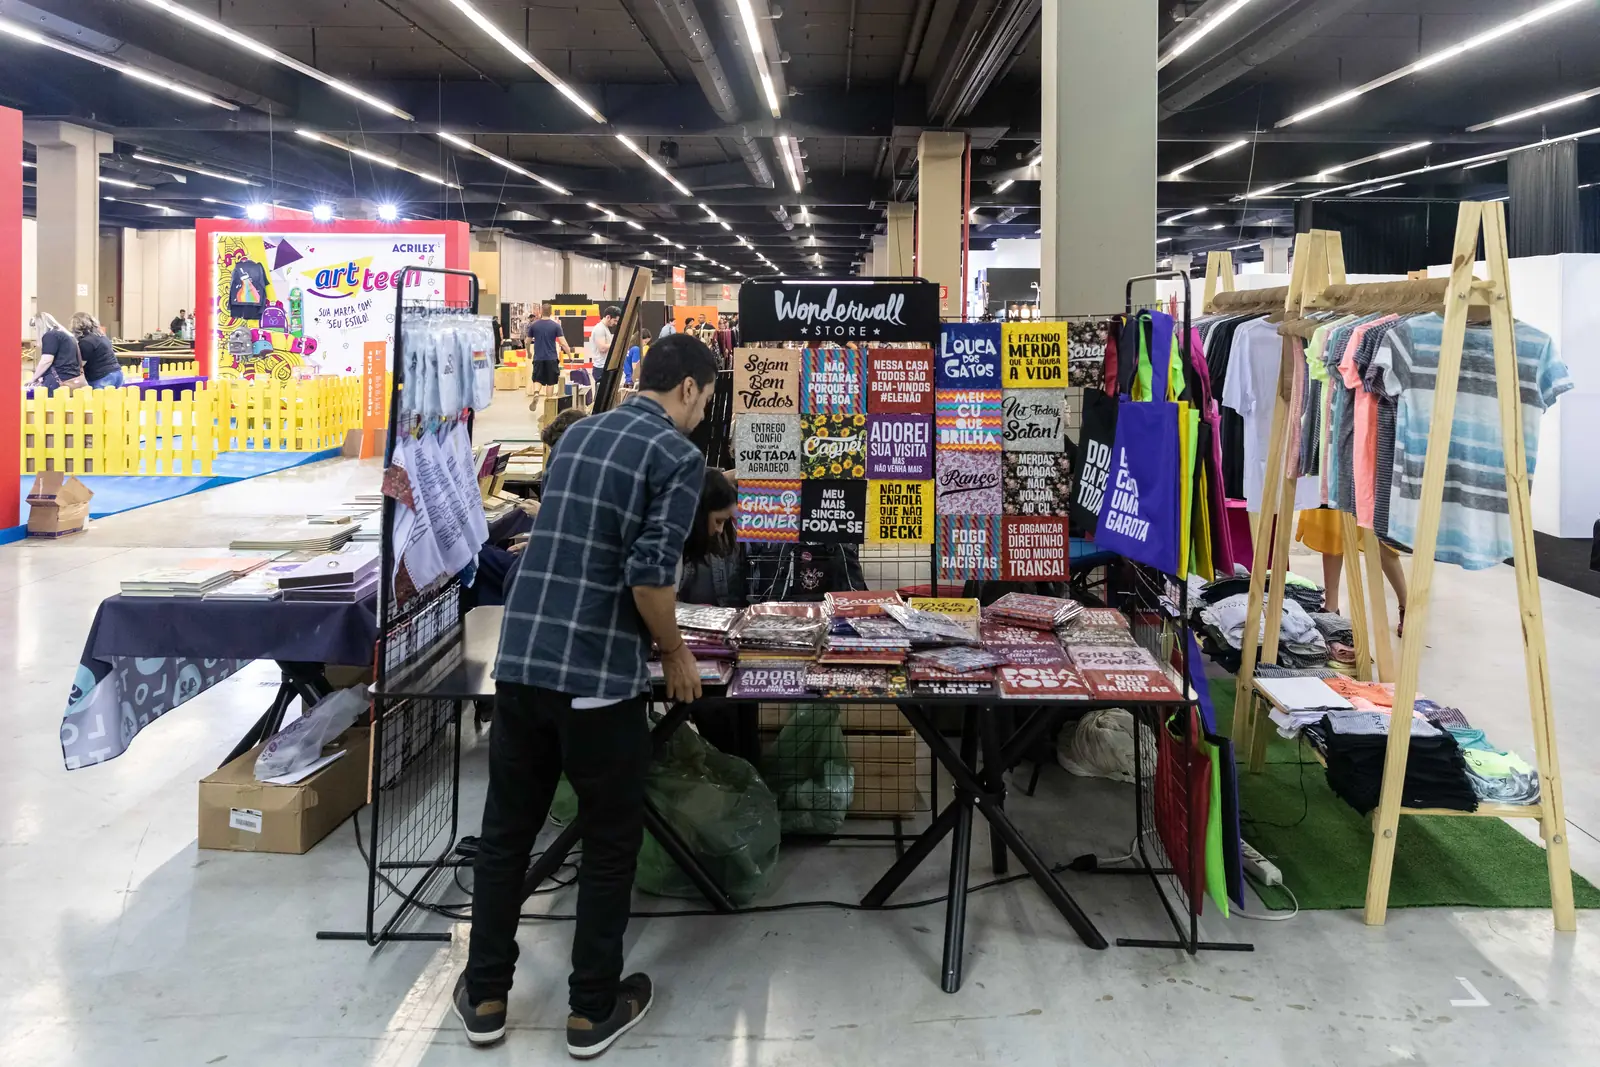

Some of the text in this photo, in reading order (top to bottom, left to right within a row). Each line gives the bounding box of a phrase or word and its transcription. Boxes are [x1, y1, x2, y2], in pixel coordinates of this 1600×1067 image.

[392, 244, 435, 253] ACRILEX
[315, 262, 359, 290] art
[318, 307, 331, 317] SUA
[334, 305, 356, 317] MARCA
[774, 287, 907, 326] Wonderwall
[328, 318, 342, 329] SEU
[814, 325, 867, 337] STORE
[1008, 331, 1060, 343] É FAZENDO
[940, 332, 997, 358] LOUCA
[1008, 343, 1061, 358] MERDA
[744, 354, 789, 375] Sejam
[962, 354, 980, 363] DOS
[1009, 358, 1022, 366] QUE
[1026, 358, 1034, 366] SE
[823, 360, 845, 372] NÃO
[874, 359, 929, 371] NESSA CASA
[944, 359, 994, 379] GATOS
[876, 369, 926, 381] TODOS SÃO
[1010, 366, 1062, 380] A VIDA
[749, 375, 784, 390] Bem
[871, 381, 931, 393] BEM-VINDOS
[808, 383, 845, 395] PORQUE
[738, 390, 794, 409] Viados
[816, 394, 851, 405] DE BOA
[880, 392, 921, 404] #ELENÃO
[954, 392, 985, 404] MEU
[957, 404, 981, 417] CU
[1002, 396, 1060, 420] Not Today
[751, 422, 786, 433] ENTREGO
[955, 418, 983, 430] QUE
[1003, 418, 1061, 441] Satan!
[754, 432, 782, 443] CONFIO
[870, 421, 929, 443] ADOREI
[940, 429, 997, 445] BRILHA
[803, 434, 864, 459] Caguei
[871, 443, 927, 457] SUA VISITA
[739, 450, 797, 462] SURTADA
[892, 456, 905, 465] MAS
[1018, 453, 1055, 465] MERDAS
[748, 462, 789, 474] AGRADEÇO
[874, 463, 923, 473] NÃO VENHA MAIS
[1016, 466, 1057, 477] CAGADAS
[1082, 463, 1096, 485] DA
[940, 469, 999, 490] Ranço
[1027, 477, 1045, 489] NÃO
[822, 489, 845, 499] MEU
[880, 482, 921, 494] NÃO ME
[880, 495, 922, 505] ENROLA
[1019, 489, 1053, 501] VOLTAM
[741, 495, 780, 512] GIRL
[821, 499, 846, 509] MAIS
[1022, 502, 1050, 513] AO CU
[1111, 489, 1139, 516] UMA
[811, 509, 855, 520] SINCERO
[880, 505, 922, 516] QUE NÃO
[741, 514, 799, 530] POWER
[802, 519, 863, 533] FODA-SE
[880, 516, 922, 525] SOU TEUS
[1105, 510, 1150, 542] GAROTA
[879, 525, 923, 539] BECK!
[1008, 523, 1063, 535] SE ORGANIZAR
[952, 529, 986, 544] FOGO
[1008, 534, 1064, 548] DIREITINHO
[957, 544, 982, 556] NOS
[1008, 548, 1064, 559] TODO MUNDO
[941, 556, 997, 570] RACISTAS
[1009, 560, 1065, 577] TRANSA!
[1082, 658, 1151, 666] POWER
[1002, 668, 1076, 676] DONA
[1105, 673, 1150, 682] FOGO
[1006, 679, 1083, 688] TODA
[1096, 685, 1171, 693] RACISTAS
